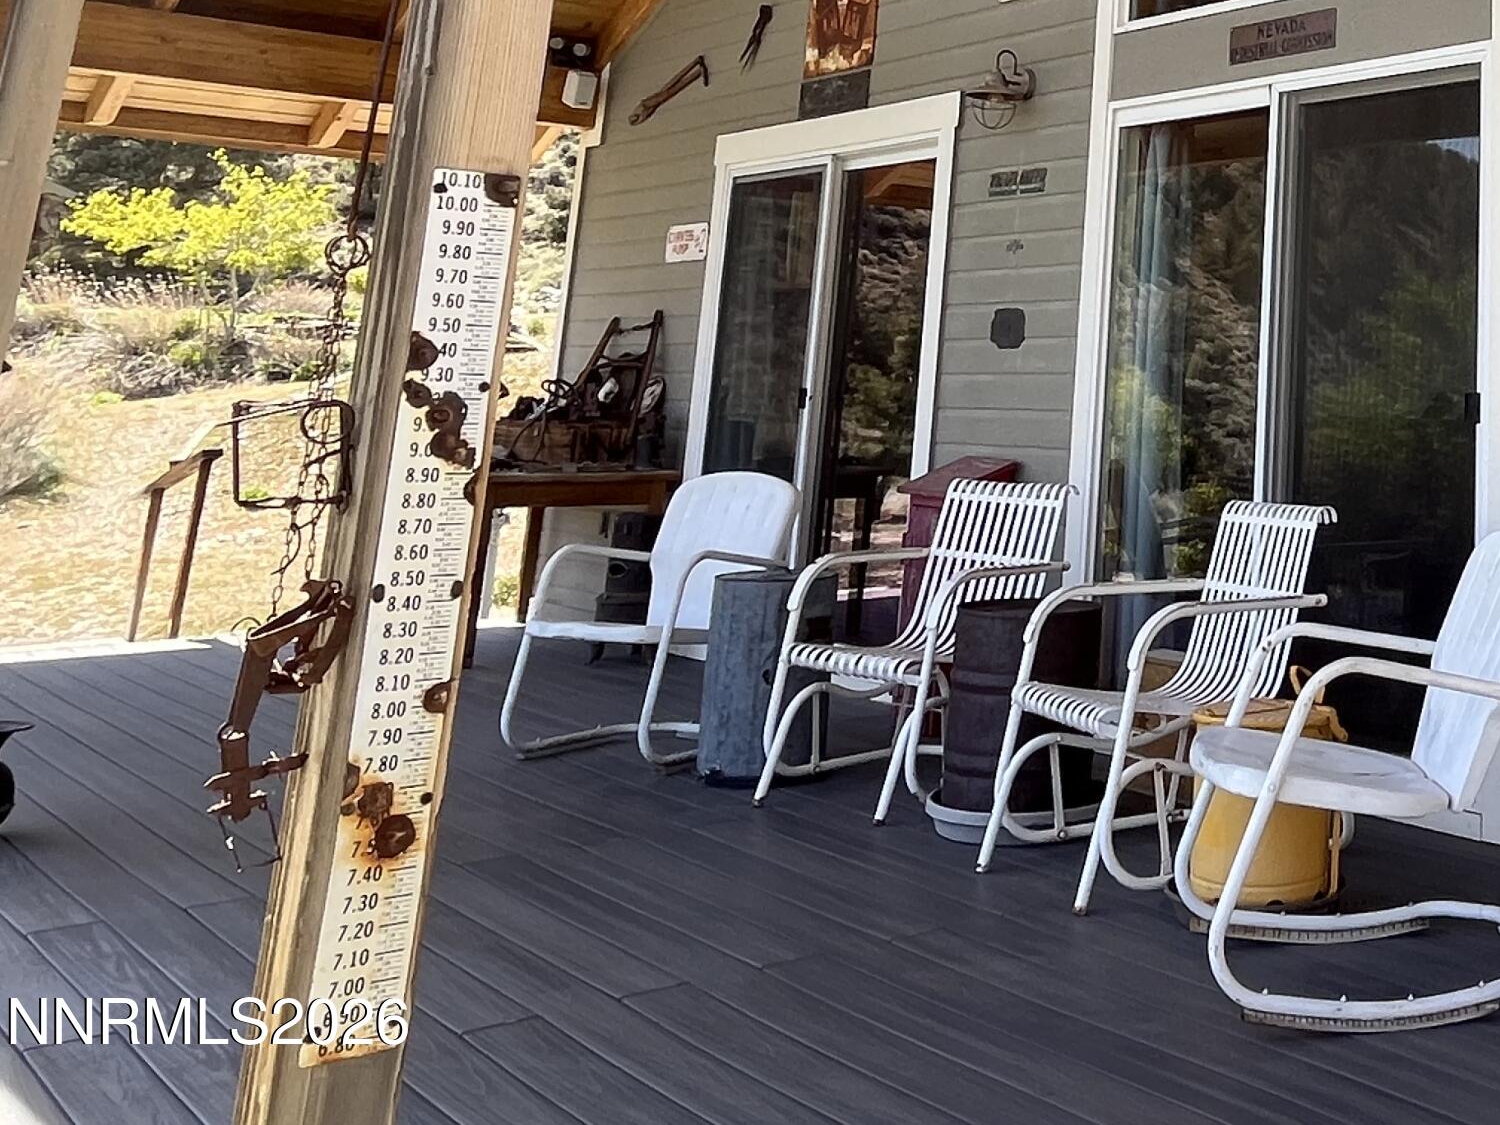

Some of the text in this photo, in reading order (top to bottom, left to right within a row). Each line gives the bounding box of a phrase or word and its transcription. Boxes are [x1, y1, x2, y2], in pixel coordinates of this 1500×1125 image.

[1257, 19, 1307, 40] NEVADA
[441, 171, 481, 189] 10.10
[436, 195, 478, 212] 10.00
[442, 219, 475, 236] 9.90
[438, 243, 472, 260] 9.80
[435, 267, 468, 284] 9.70
[432, 292, 465, 309] 9.60
[428, 317, 461, 333] 9.50
[421, 367, 454, 383] 9.30
[409, 442, 432, 458] 9.0
[405, 467, 440, 484] 8.90
[401, 492, 436, 509] 8.80
[397, 518, 432, 535] 8.70
[394, 544, 429, 561] 8.60
[390, 570, 425, 587] 8.50
[386, 595, 421, 613] 8.40
[382, 621, 418, 639] 8.30
[379, 647, 414, 665] 8.20
[375, 674, 410, 693] 8.10
[371, 700, 407, 720] 8.00
[367, 727, 402, 747] 7.90
[363, 754, 399, 775] 7.80
[347, 864, 383, 887] 7.40
[342, 892, 379, 914] 7.30
[338, 921, 374, 943] 7.20
[333, 948, 370, 971] 7.10
[328, 977, 365, 1000] 7.00
[317, 1034, 356, 1058] 6.80
